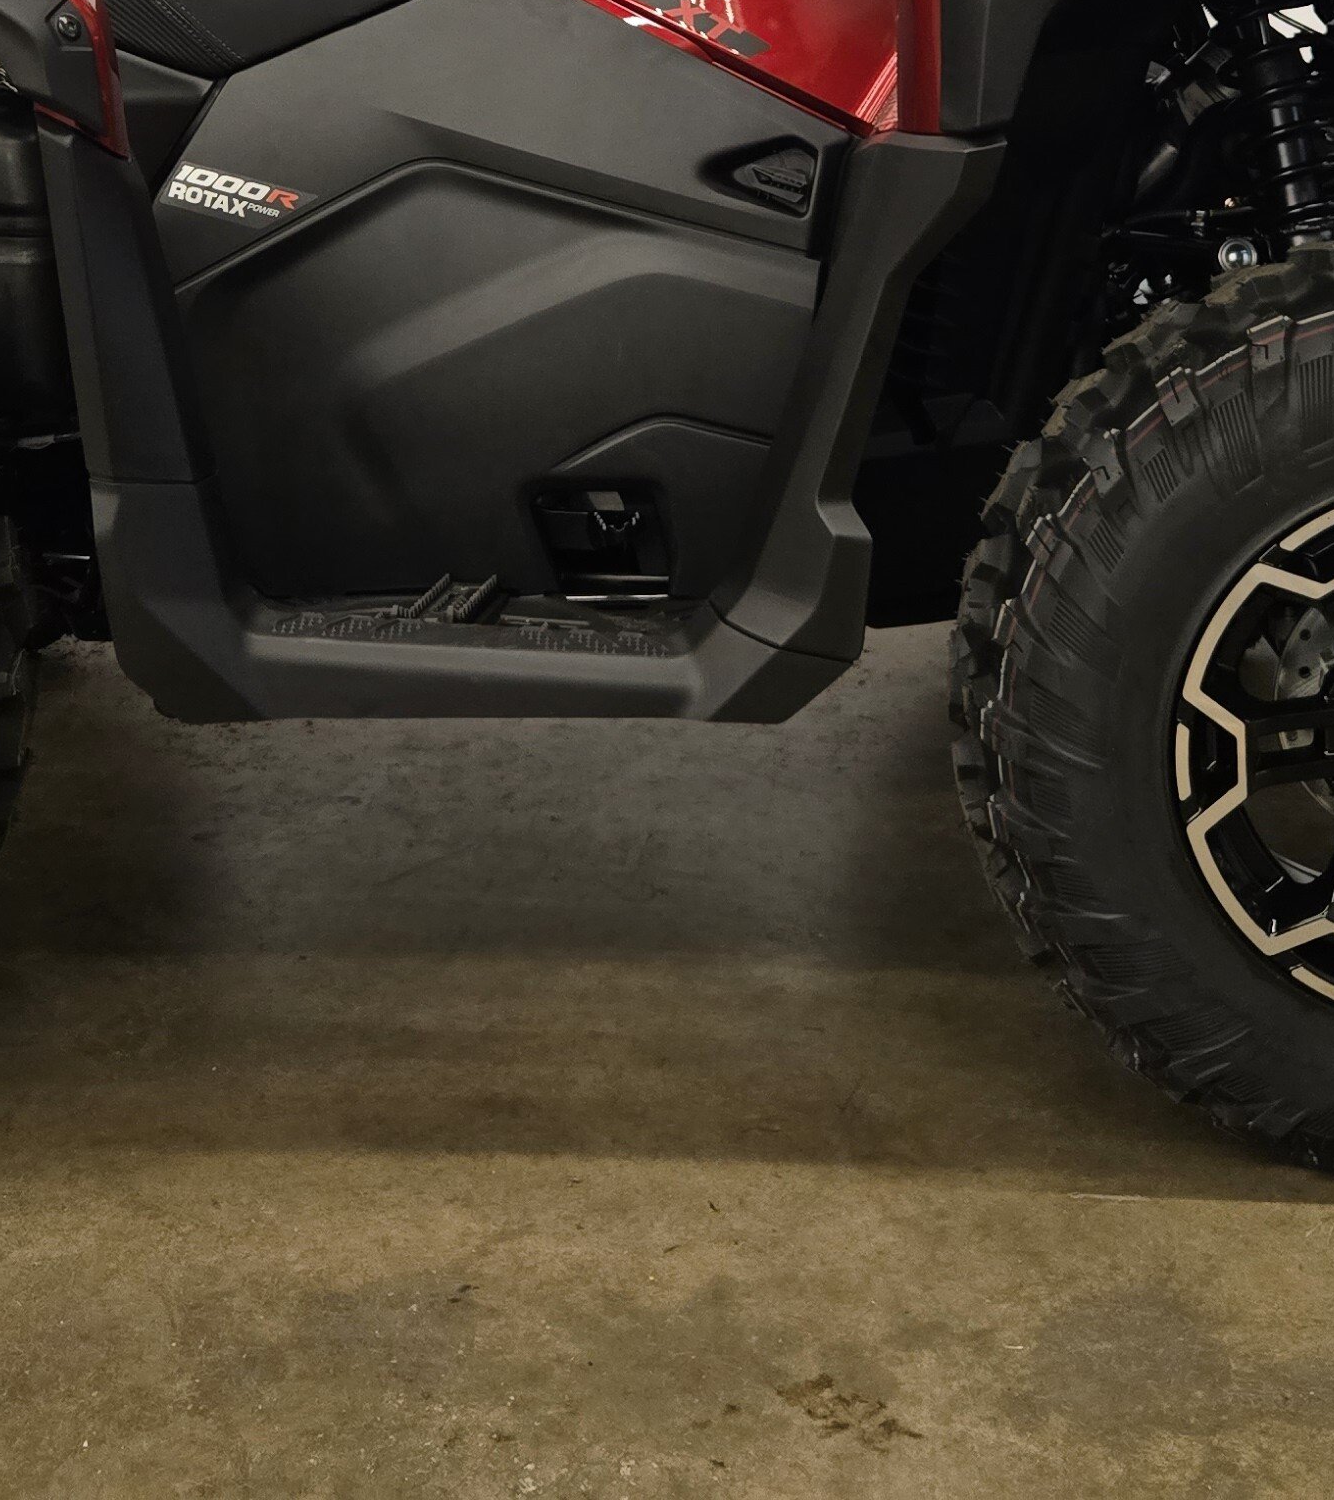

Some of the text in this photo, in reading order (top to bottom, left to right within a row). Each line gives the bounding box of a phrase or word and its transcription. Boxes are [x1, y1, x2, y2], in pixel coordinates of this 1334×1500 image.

[663, 0, 746, 40] XT
[168, 181, 280, 218] ROTAX POWER
[174, 164, 299, 210] 1000R
